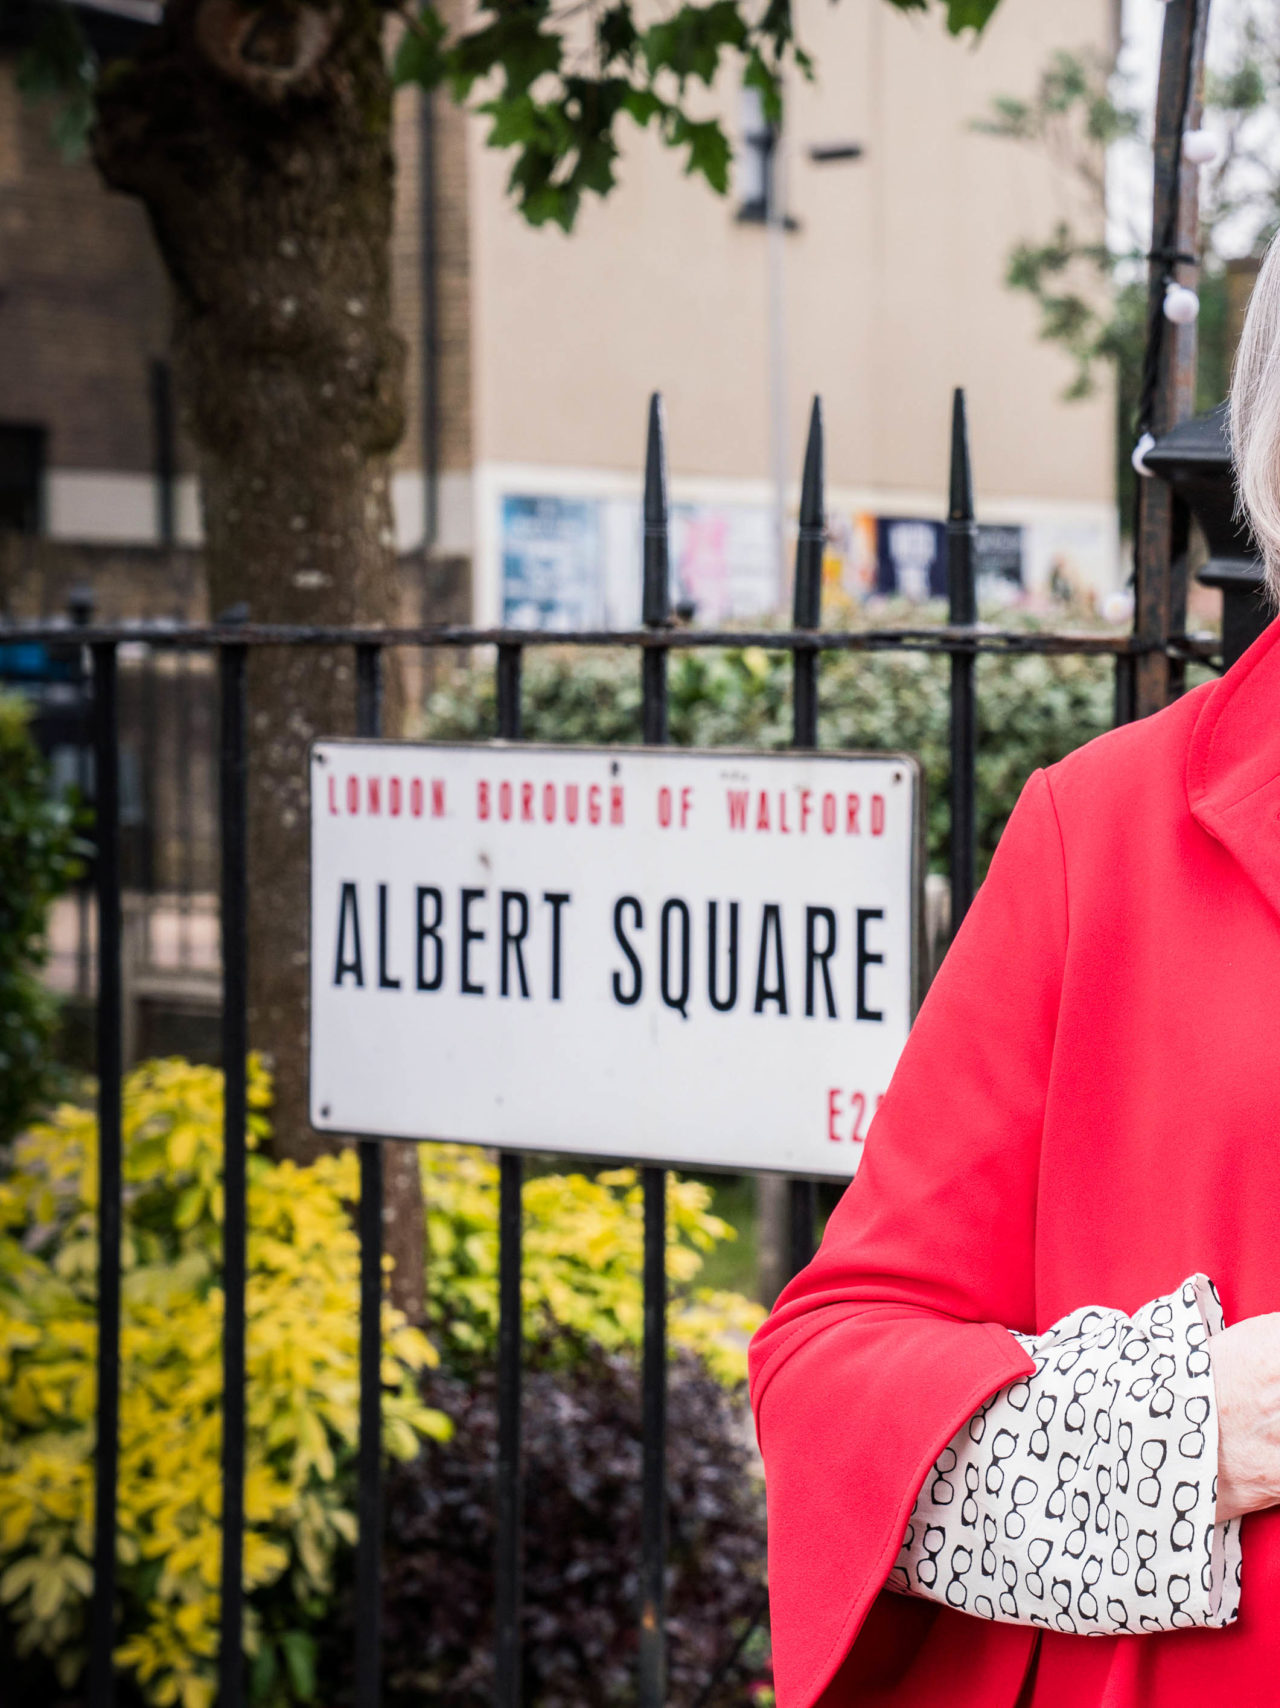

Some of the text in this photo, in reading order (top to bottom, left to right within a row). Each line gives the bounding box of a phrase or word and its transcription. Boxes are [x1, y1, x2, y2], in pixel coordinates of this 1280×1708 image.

[327, 774, 885, 837] LONDON BOROUGH OF WALFORD
[334, 881, 884, 1021] ALBERT SQUARE
[827, 1088, 886, 1144] E2
